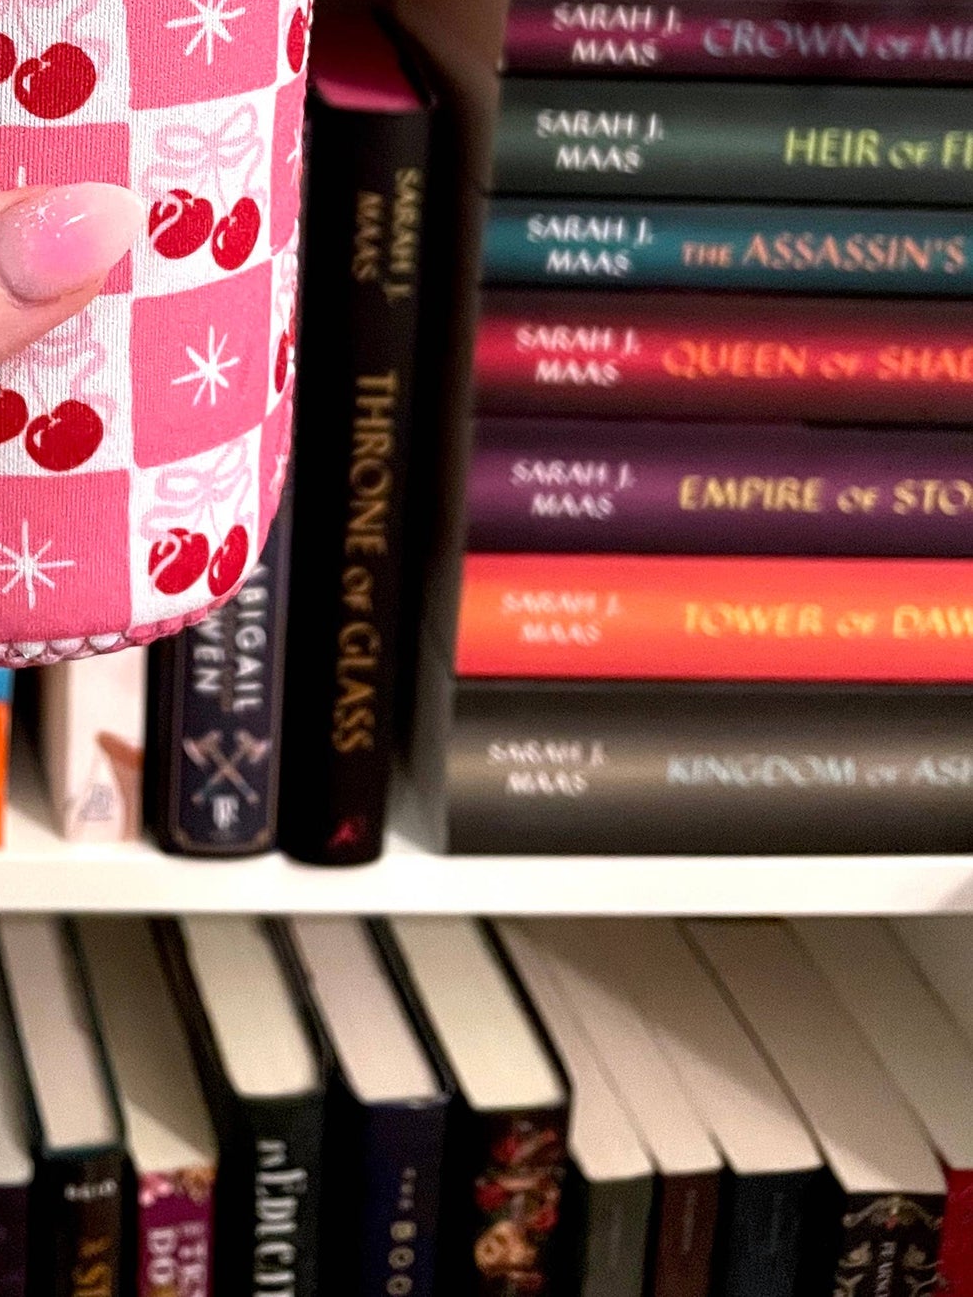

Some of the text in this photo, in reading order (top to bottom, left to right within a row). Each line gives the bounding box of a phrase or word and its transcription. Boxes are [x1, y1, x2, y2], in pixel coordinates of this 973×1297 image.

[552, 3, 653, 32] SARAH
[571, 38, 658, 67] MAAS
[702, 18, 872, 59] CROWN
[536, 108, 636, 139] SARAH
[555, 144, 642, 174] MAAS
[784, 127, 881, 168] HEIR
[527, 213, 626, 243] SARAH
[545, 248, 632, 279] MAAS
[741, 231, 966, 275] ASSASSIN'S
[515, 323, 614, 353] SARAH
[534, 358, 621, 389] MAAS
[660, 339, 808, 380] QUEEN
[344, 373, 397, 554] THRONE
[509, 458, 610, 487] SARAH
[530, 492, 616, 521] MAAS
[678, 474, 826, 514] EMPIRE
[500, 590, 598, 617] SARAH
[520, 619, 603, 647] MAAS
[684, 602, 824, 639] TOWER
[192, 608, 227, 693] WEN
[330, 620, 380, 754] GLASS
[486, 737, 584, 766] SARAH
[504, 769, 590, 798] MAAS
